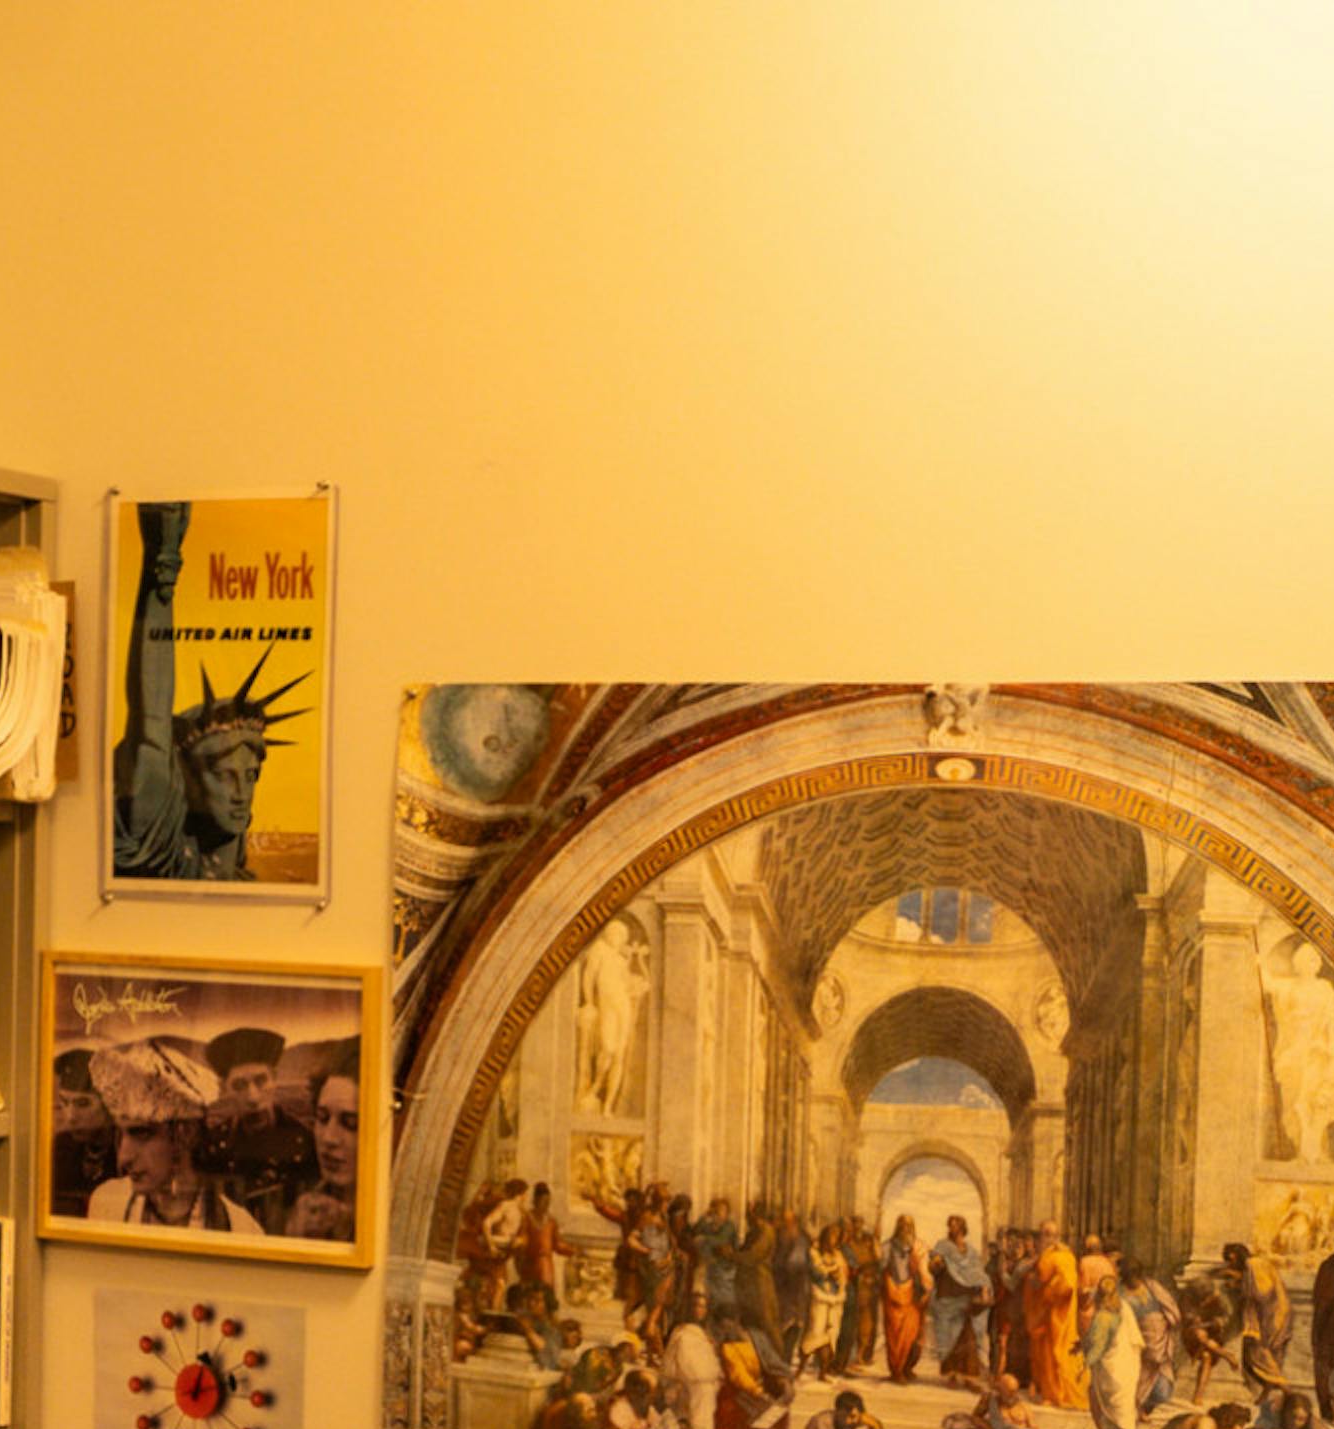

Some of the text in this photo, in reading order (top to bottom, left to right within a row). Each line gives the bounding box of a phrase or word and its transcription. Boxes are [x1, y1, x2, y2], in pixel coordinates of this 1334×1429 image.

[209, 551, 314, 600] New York
[148, 627, 313, 642] UNITED AIR LINES
